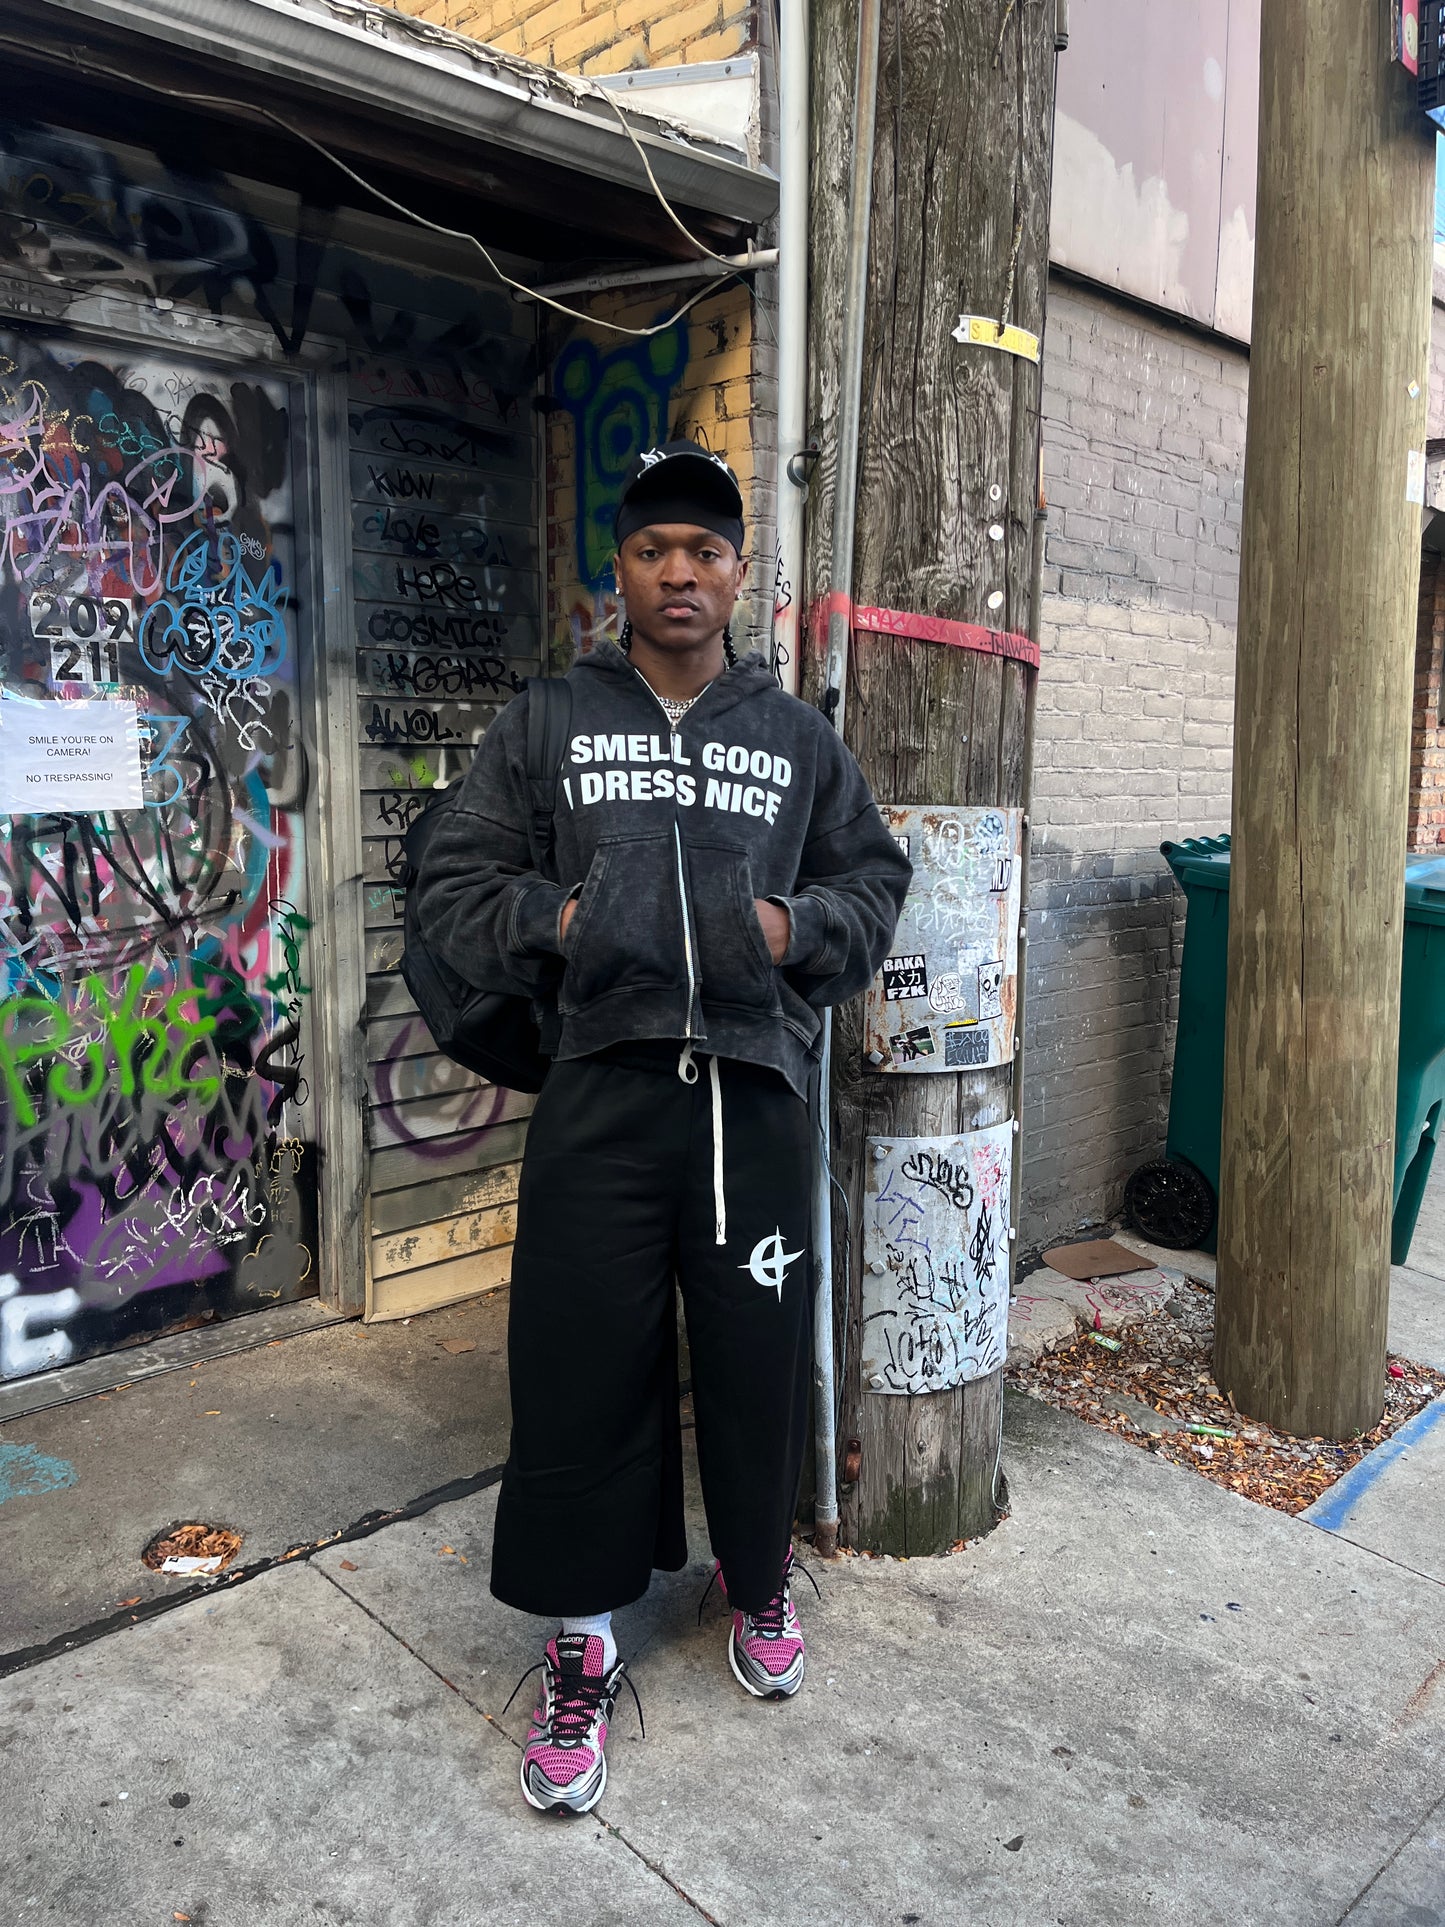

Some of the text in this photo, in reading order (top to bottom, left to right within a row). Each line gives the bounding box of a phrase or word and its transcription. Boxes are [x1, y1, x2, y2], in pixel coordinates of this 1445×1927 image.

[32, 594, 130, 640] 209
[53, 640, 119, 682] 211
[28, 735, 114, 745] SMILE YOU'RE ON
[46, 748, 91, 757] CAMERA!
[570, 734, 792, 788] SMELL GOOD
[26, 772, 113, 783] NO TRESPASSING!
[580, 769, 697, 807] DRESS
[704, 778, 782, 826] NICE
[883, 956, 925, 972] BAKA
[890, 970, 921, 986] バカ
[887, 984, 926, 1000] FZK
